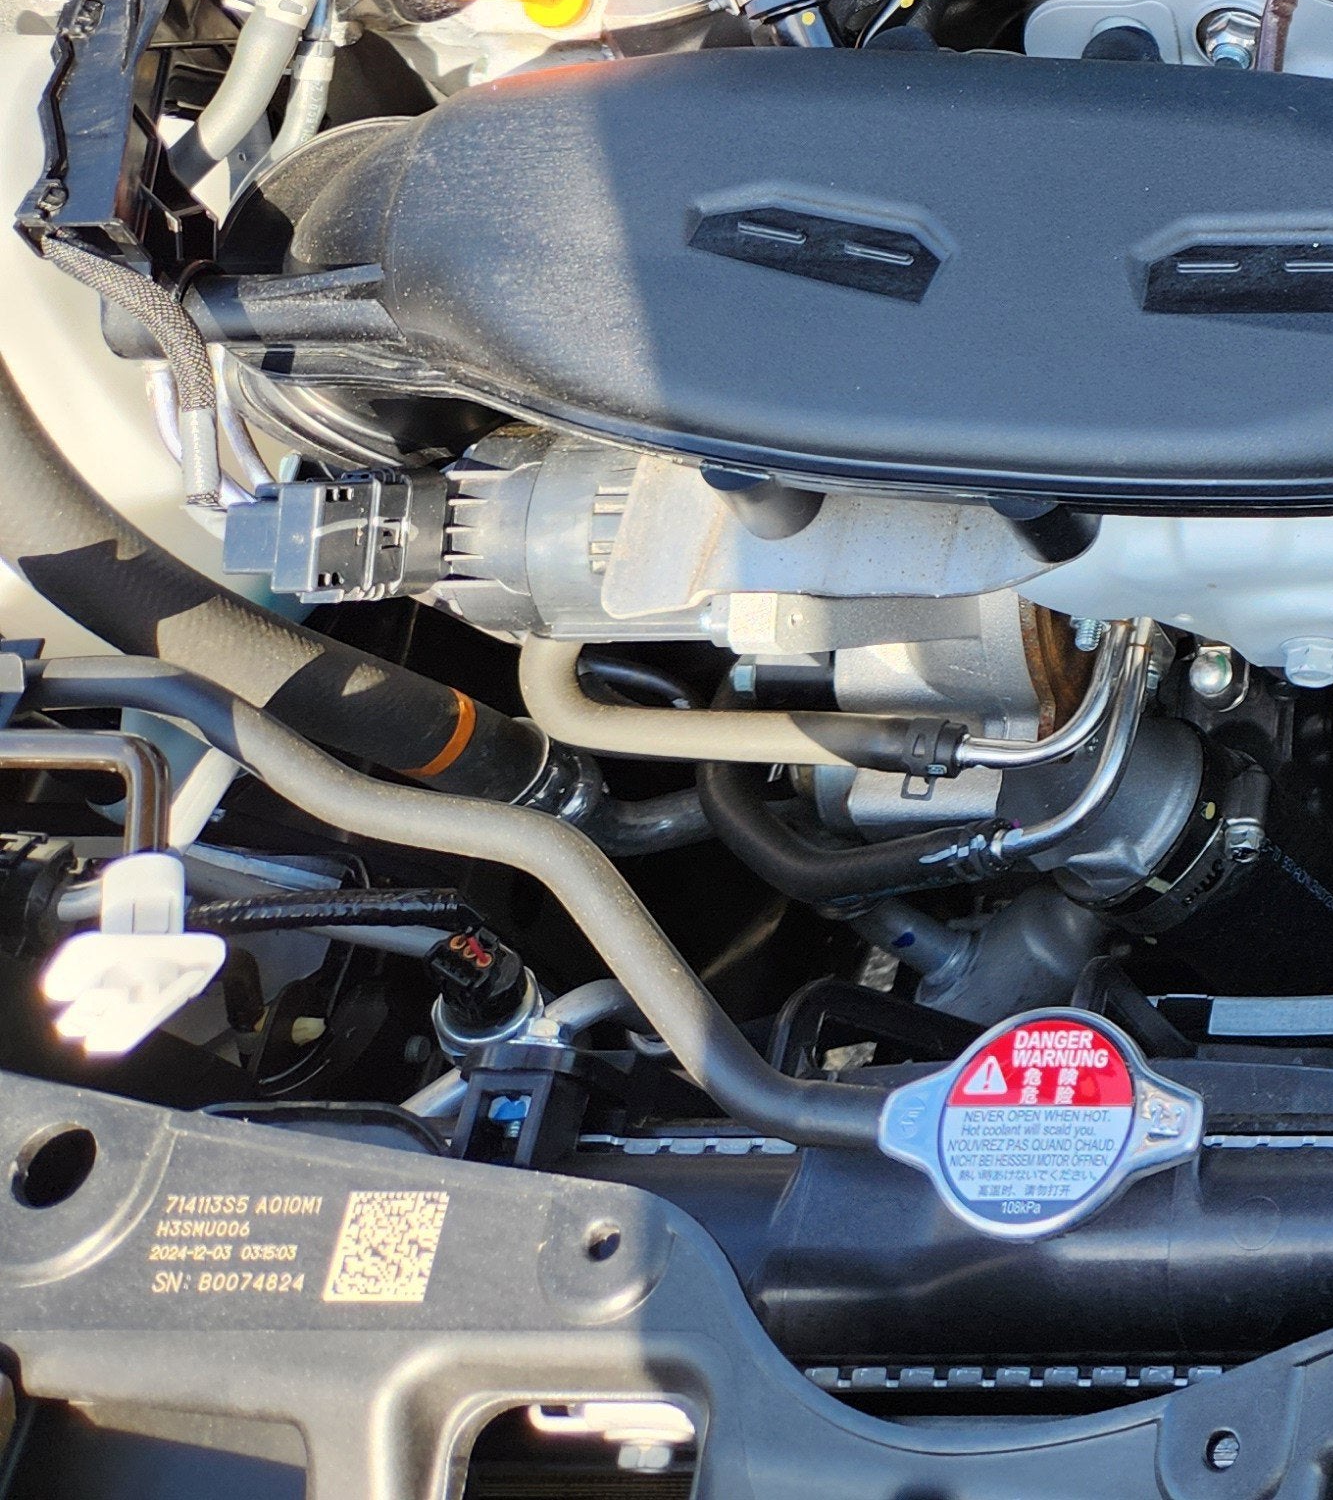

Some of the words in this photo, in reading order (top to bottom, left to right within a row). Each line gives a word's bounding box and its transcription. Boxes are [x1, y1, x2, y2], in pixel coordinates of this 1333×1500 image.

[1014, 1030, 1095, 1049] DANGER
[1012, 1049, 1109, 1068] WARNUNG
[964, 1110, 1005, 1122] NEVER
[1007, 1110, 1040, 1122] OPEN
[1044, 1110, 1081, 1122] WHEN
[1082, 1110, 1111, 1122] HOT.
[961, 1124, 980, 1136] Hot
[982, 1124, 1022, 1136] coolant
[1024, 1124, 1041, 1136] will
[1043, 1124, 1072, 1136] scald
[1074, 1126, 1096, 1139] you.
[948, 1139, 1004, 1151] N'OUVREZ
[1006, 1139, 1028, 1151] PAS
[1031, 1139, 1072, 1151] QUAND
[950, 1154, 977, 1167] NICHT
[978, 1154, 995, 1167] BEI
[996, 1154, 1036, 1167] HEISSEM
[1037, 1154, 1070, 1167] MOTOR
[166, 1195, 250, 1215] 714113S5
[255, 1196, 323, 1215] A010M1
[1001, 1201, 1042, 1215] 108kPa
[156, 1220, 250, 1238] H3SMU006
[148, 1243, 233, 1261] 2024-12-03
[240, 1244, 299, 1261] 03:15:03
[152, 1271, 192, 1293] SN:
[198, 1272, 306, 1293] B0074824
